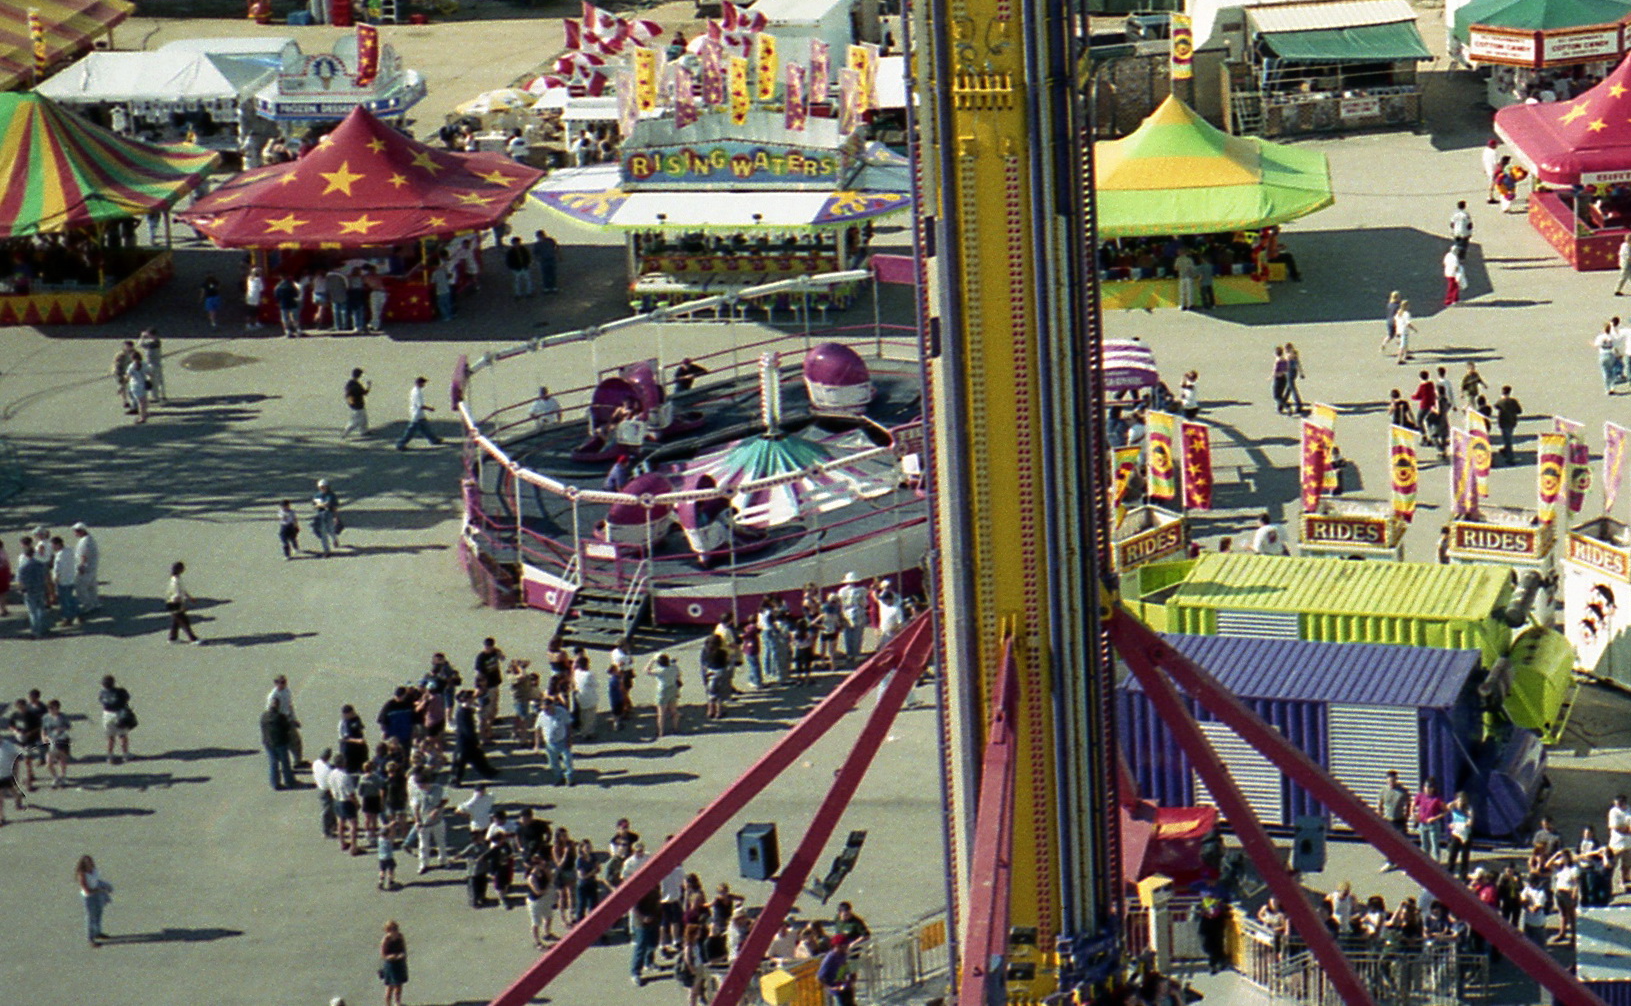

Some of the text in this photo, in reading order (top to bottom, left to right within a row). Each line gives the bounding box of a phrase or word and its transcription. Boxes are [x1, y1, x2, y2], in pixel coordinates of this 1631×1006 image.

[631, 148, 836, 177] RISING WATERS
[1127, 528, 1177, 563] RIDES
[1314, 522, 1378, 541] RIDES
[1463, 529, 1528, 551] RIDES
[1574, 541, 1624, 573] RIDES
